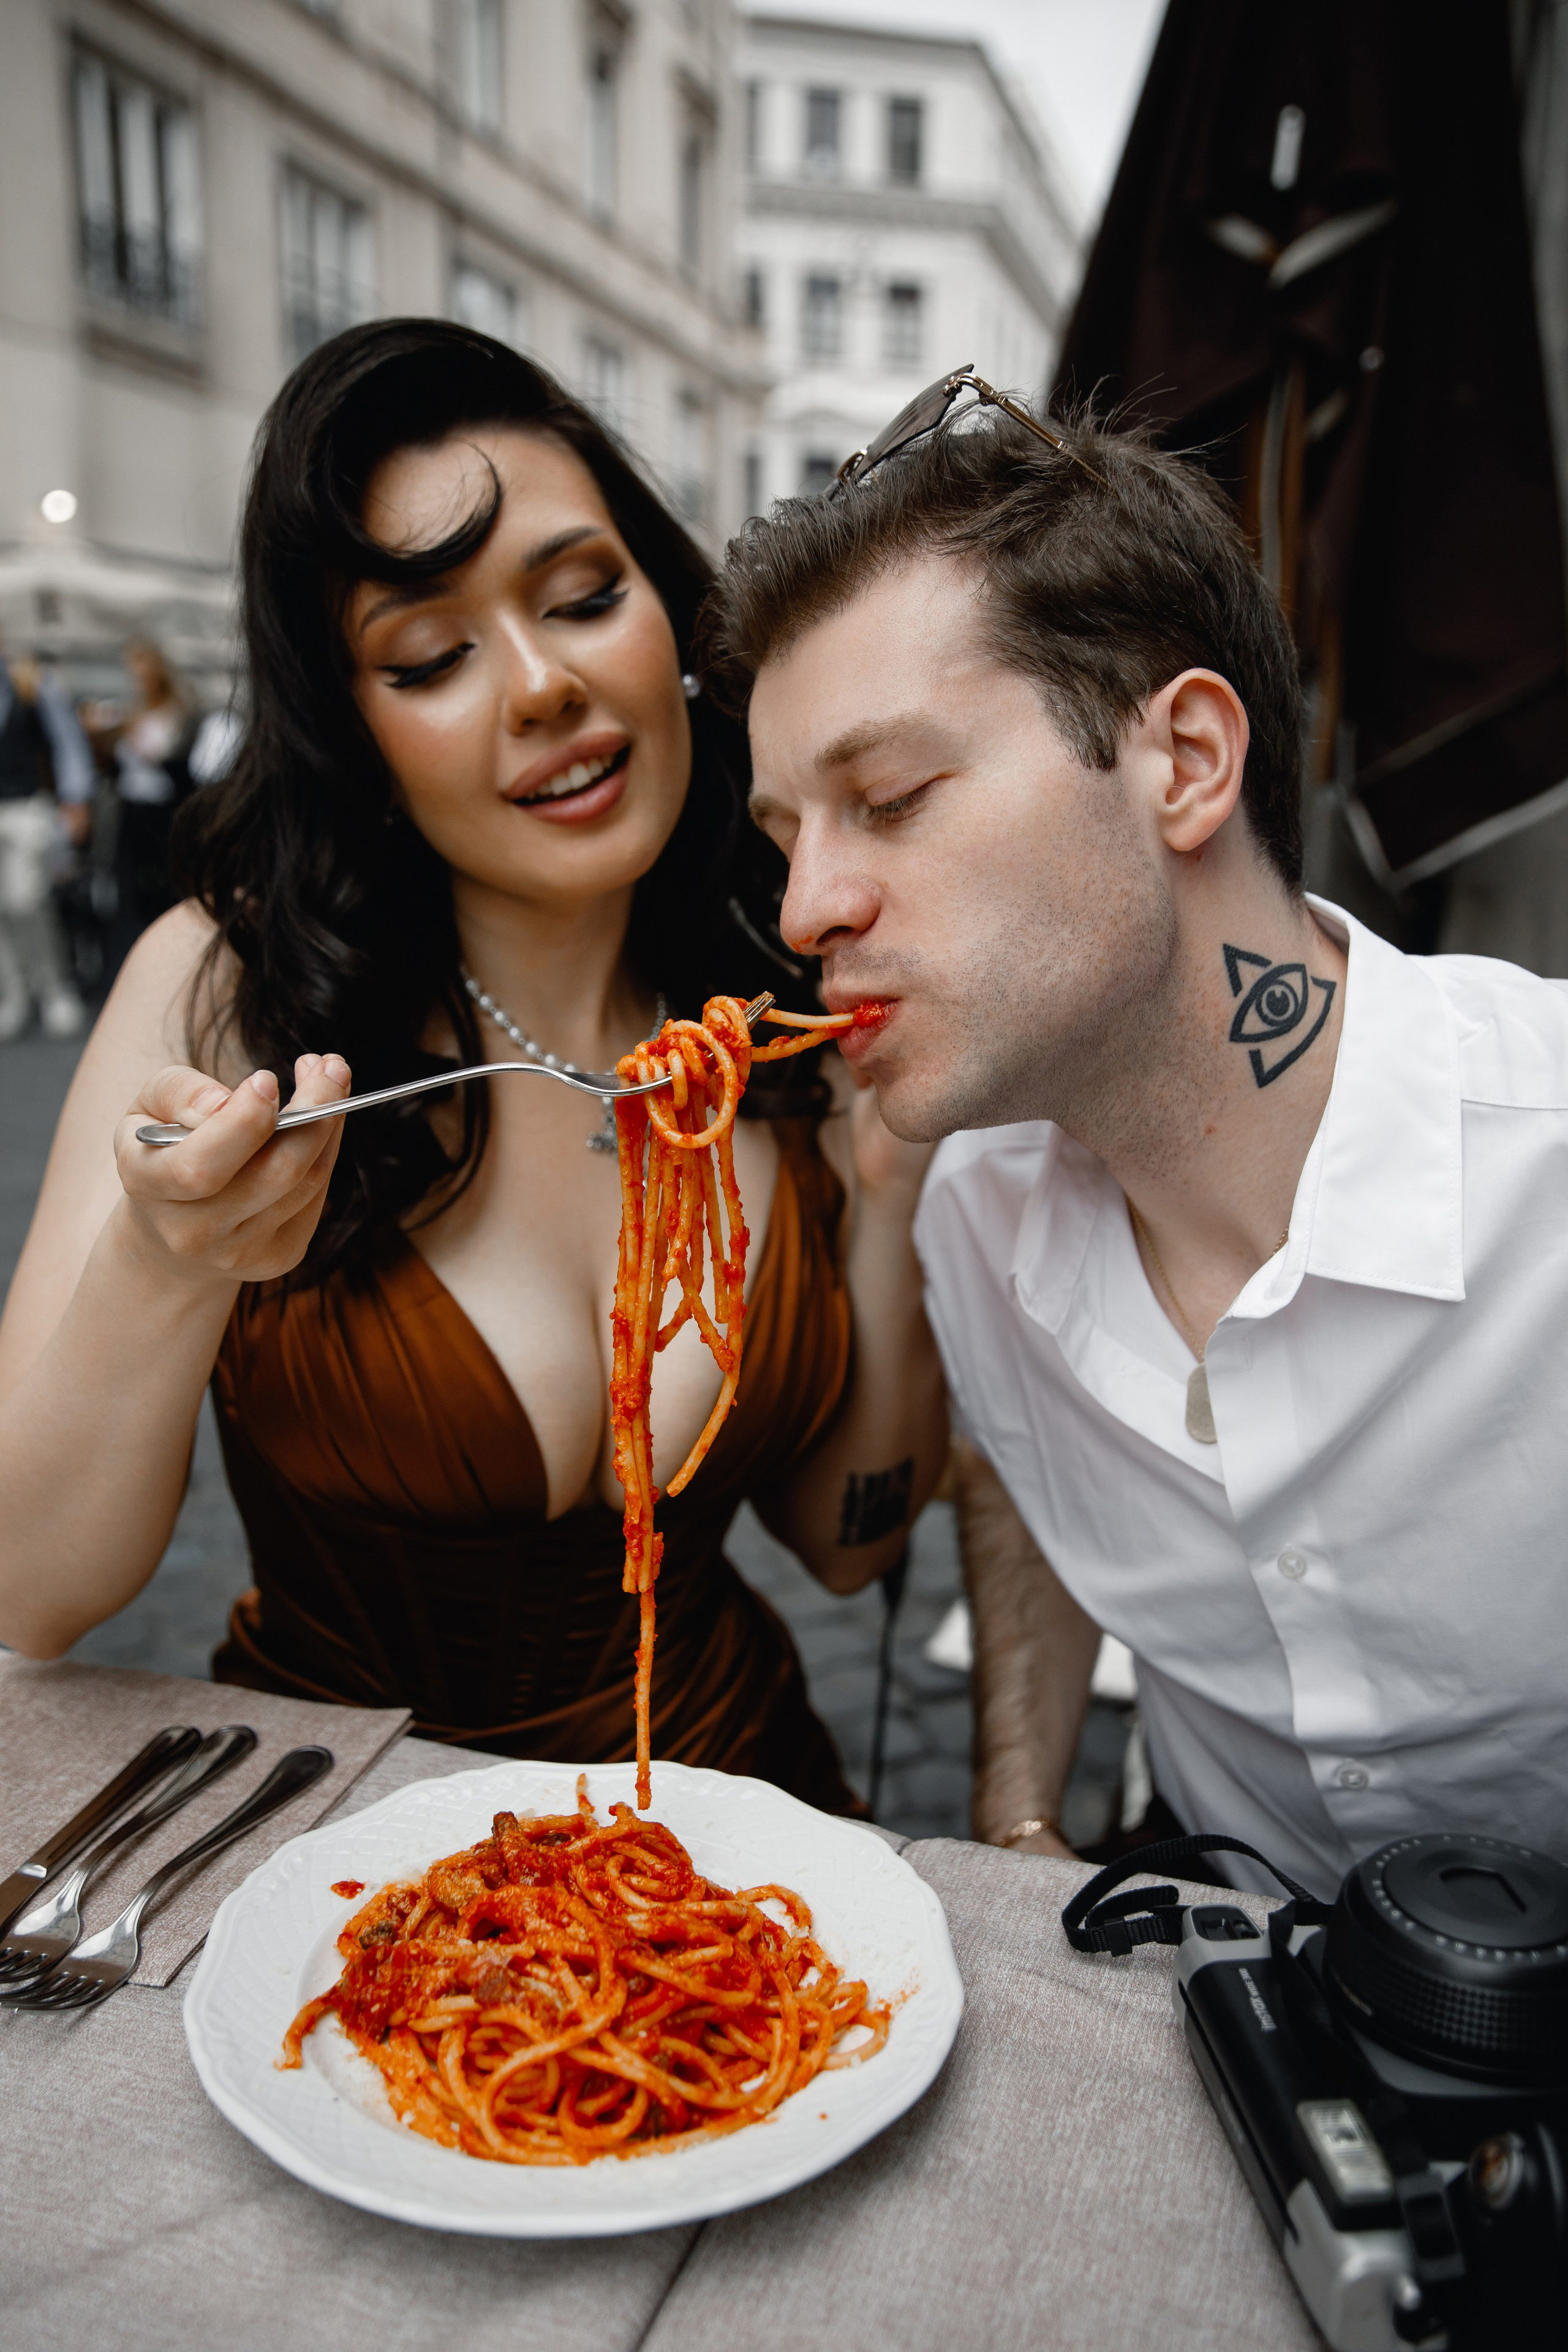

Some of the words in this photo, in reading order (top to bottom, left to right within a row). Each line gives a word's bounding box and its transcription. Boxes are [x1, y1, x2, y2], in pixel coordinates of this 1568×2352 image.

[1376, 1839, 1421, 1867] RANGE
[1373, 1879, 1415, 1929] FOCUS
[1239, 1968, 1251, 1980] 300
[1245, 1981, 1259, 1996] WIDE
[1250, 1997, 1276, 2030] instax
